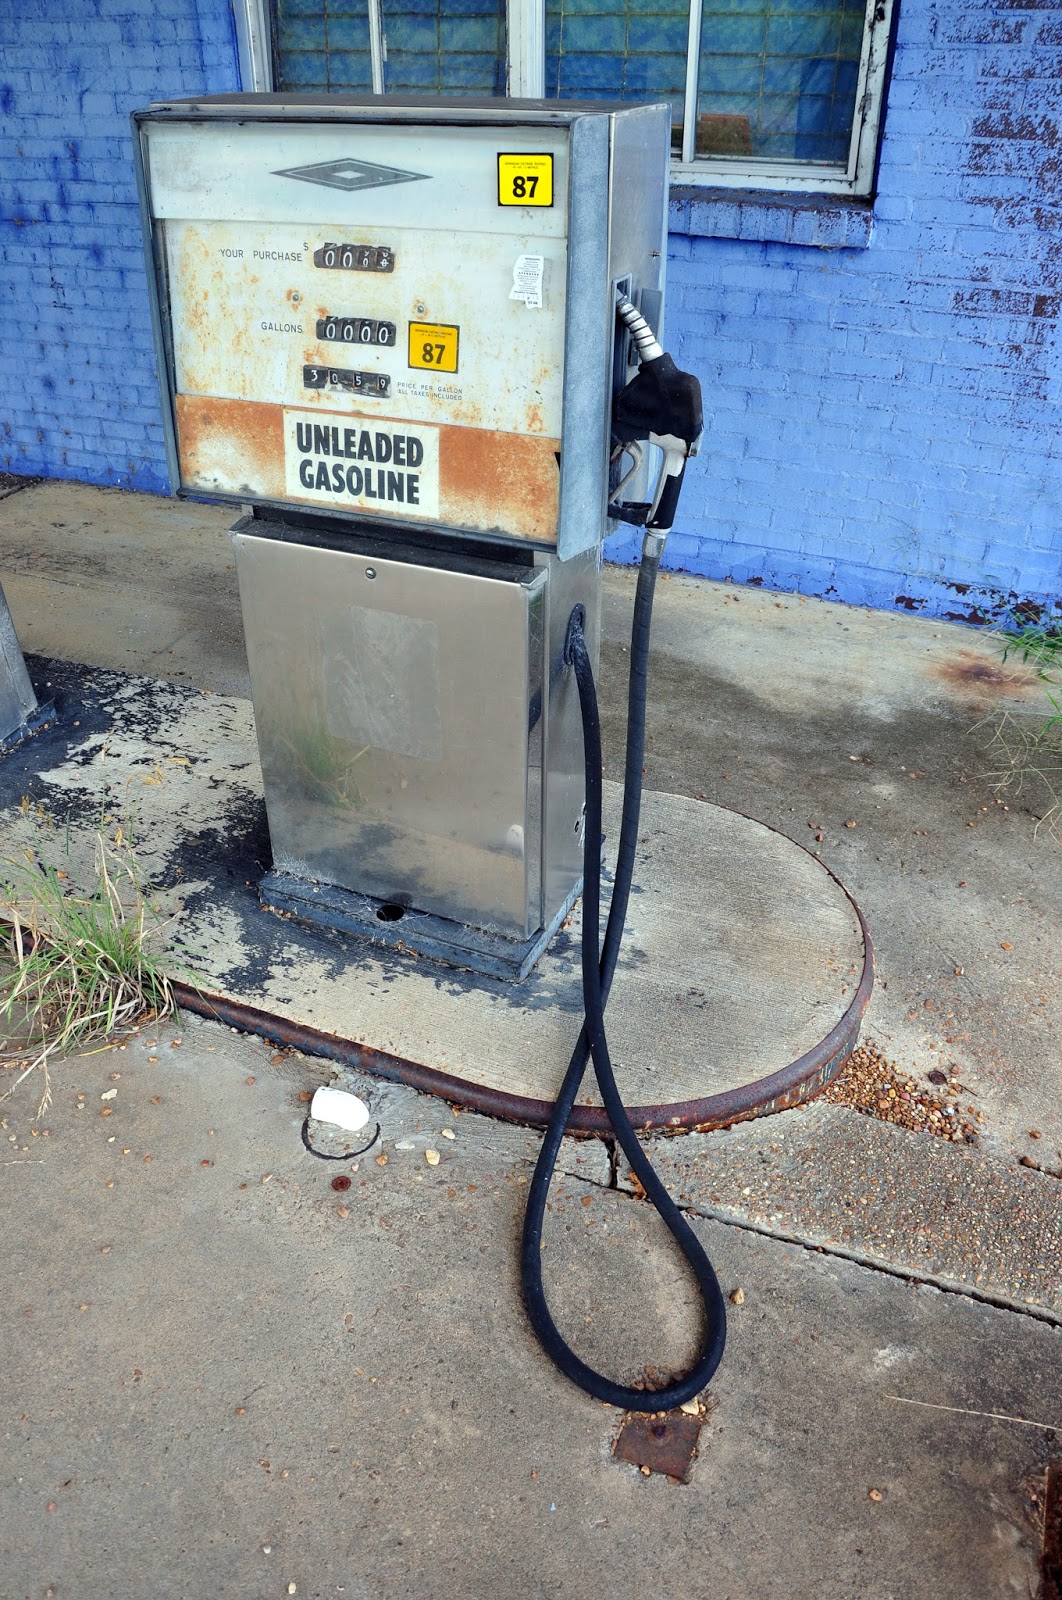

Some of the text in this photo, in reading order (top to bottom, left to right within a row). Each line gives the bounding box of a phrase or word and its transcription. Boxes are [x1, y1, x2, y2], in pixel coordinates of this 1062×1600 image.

[512, 175, 539, 198] 87
[219, 248, 244, 258] YOUR
[252, 250, 303, 262] PURCHASE
[302, 241, 309, 252] $
[260, 321, 303, 334] GALLONS
[421, 342, 446, 365] 87
[397, 381, 416, 389] PRICE
[437, 386, 463, 395] GALLON
[411, 389, 429, 397] TAXES
[430, 391, 463, 401] INCLUDED
[296, 422, 424, 468] UNLEADED
[299, 458, 420, 505] GASOLINE
